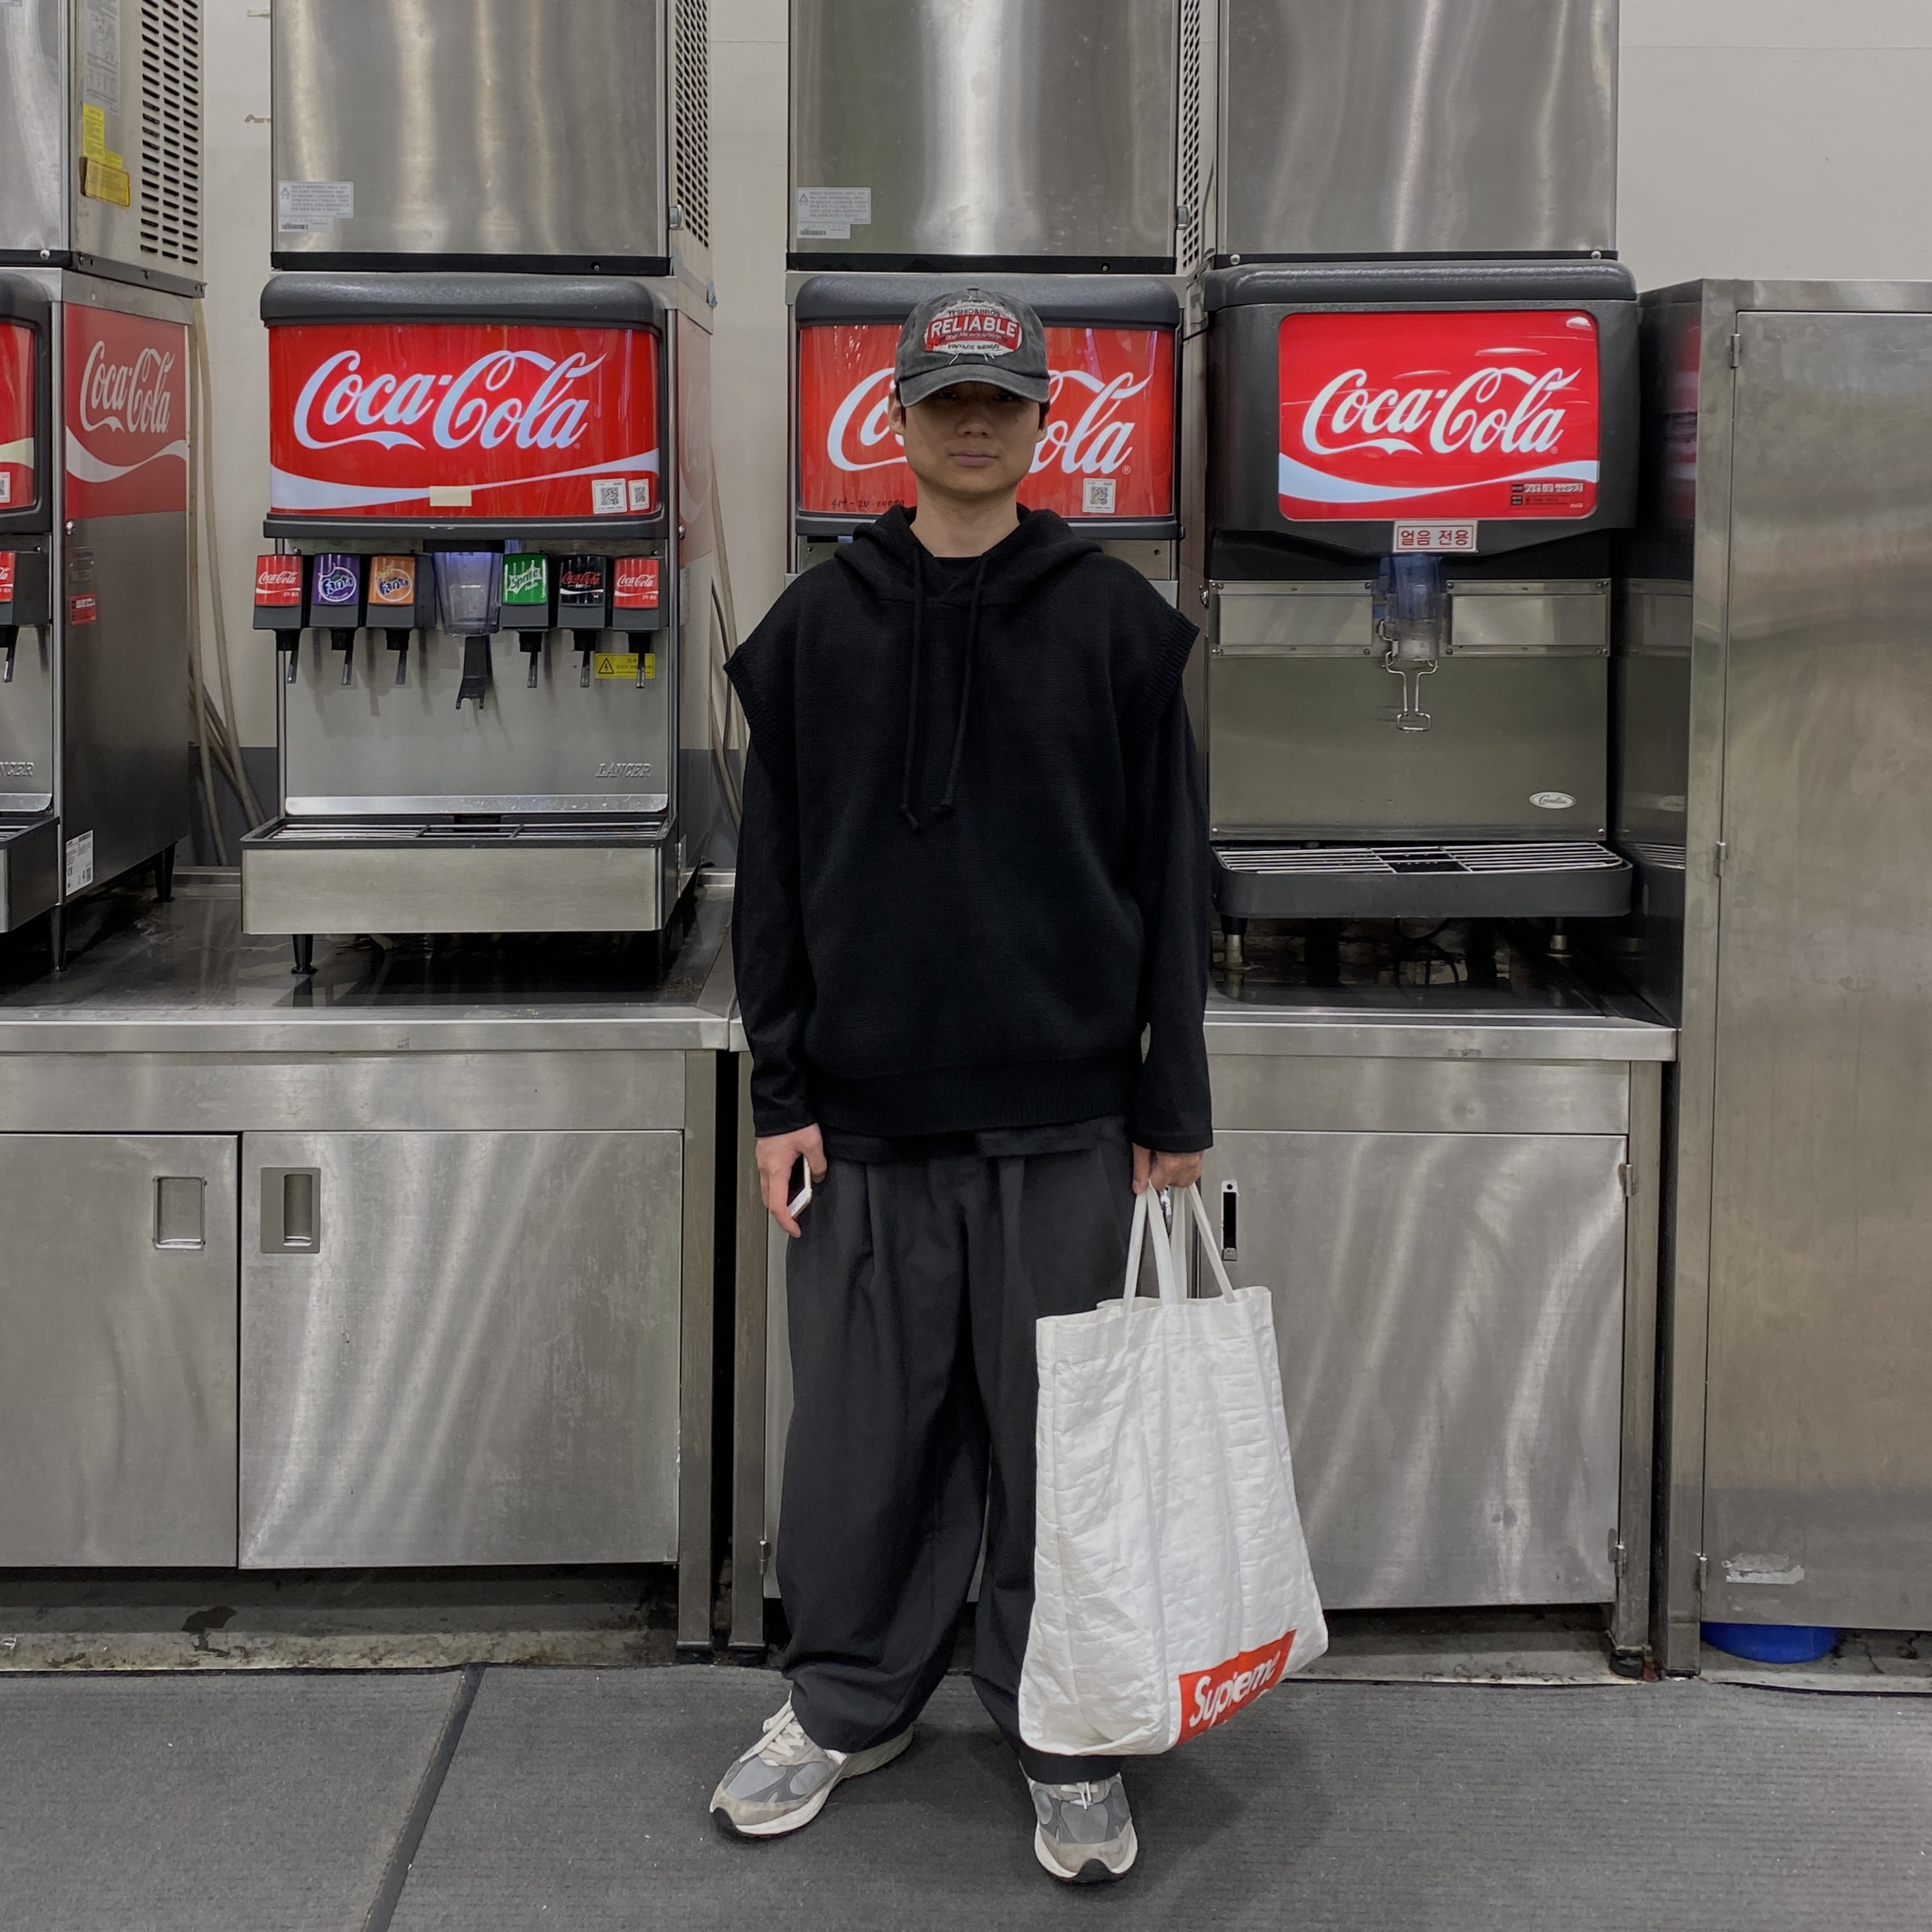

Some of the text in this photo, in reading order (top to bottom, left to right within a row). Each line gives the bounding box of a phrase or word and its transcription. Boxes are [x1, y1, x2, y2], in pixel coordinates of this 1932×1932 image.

[931, 315, 1018, 338] RELIABLE
[80, 340, 176, 433] Coca-Cola
[293, 350, 608, 450] Coca-Cola
[1302, 367, 1582, 455] Coca-Cola
[1401, 529, 1469, 546] 얼음 전용
[258, 571, 298, 585] Coca-Cola
[322, 574, 354, 596] Fanta
[379, 576, 409, 595] Fanta
[617, 574, 656, 588] Coca-Cola
[595, 762, 652, 777] LANCER
